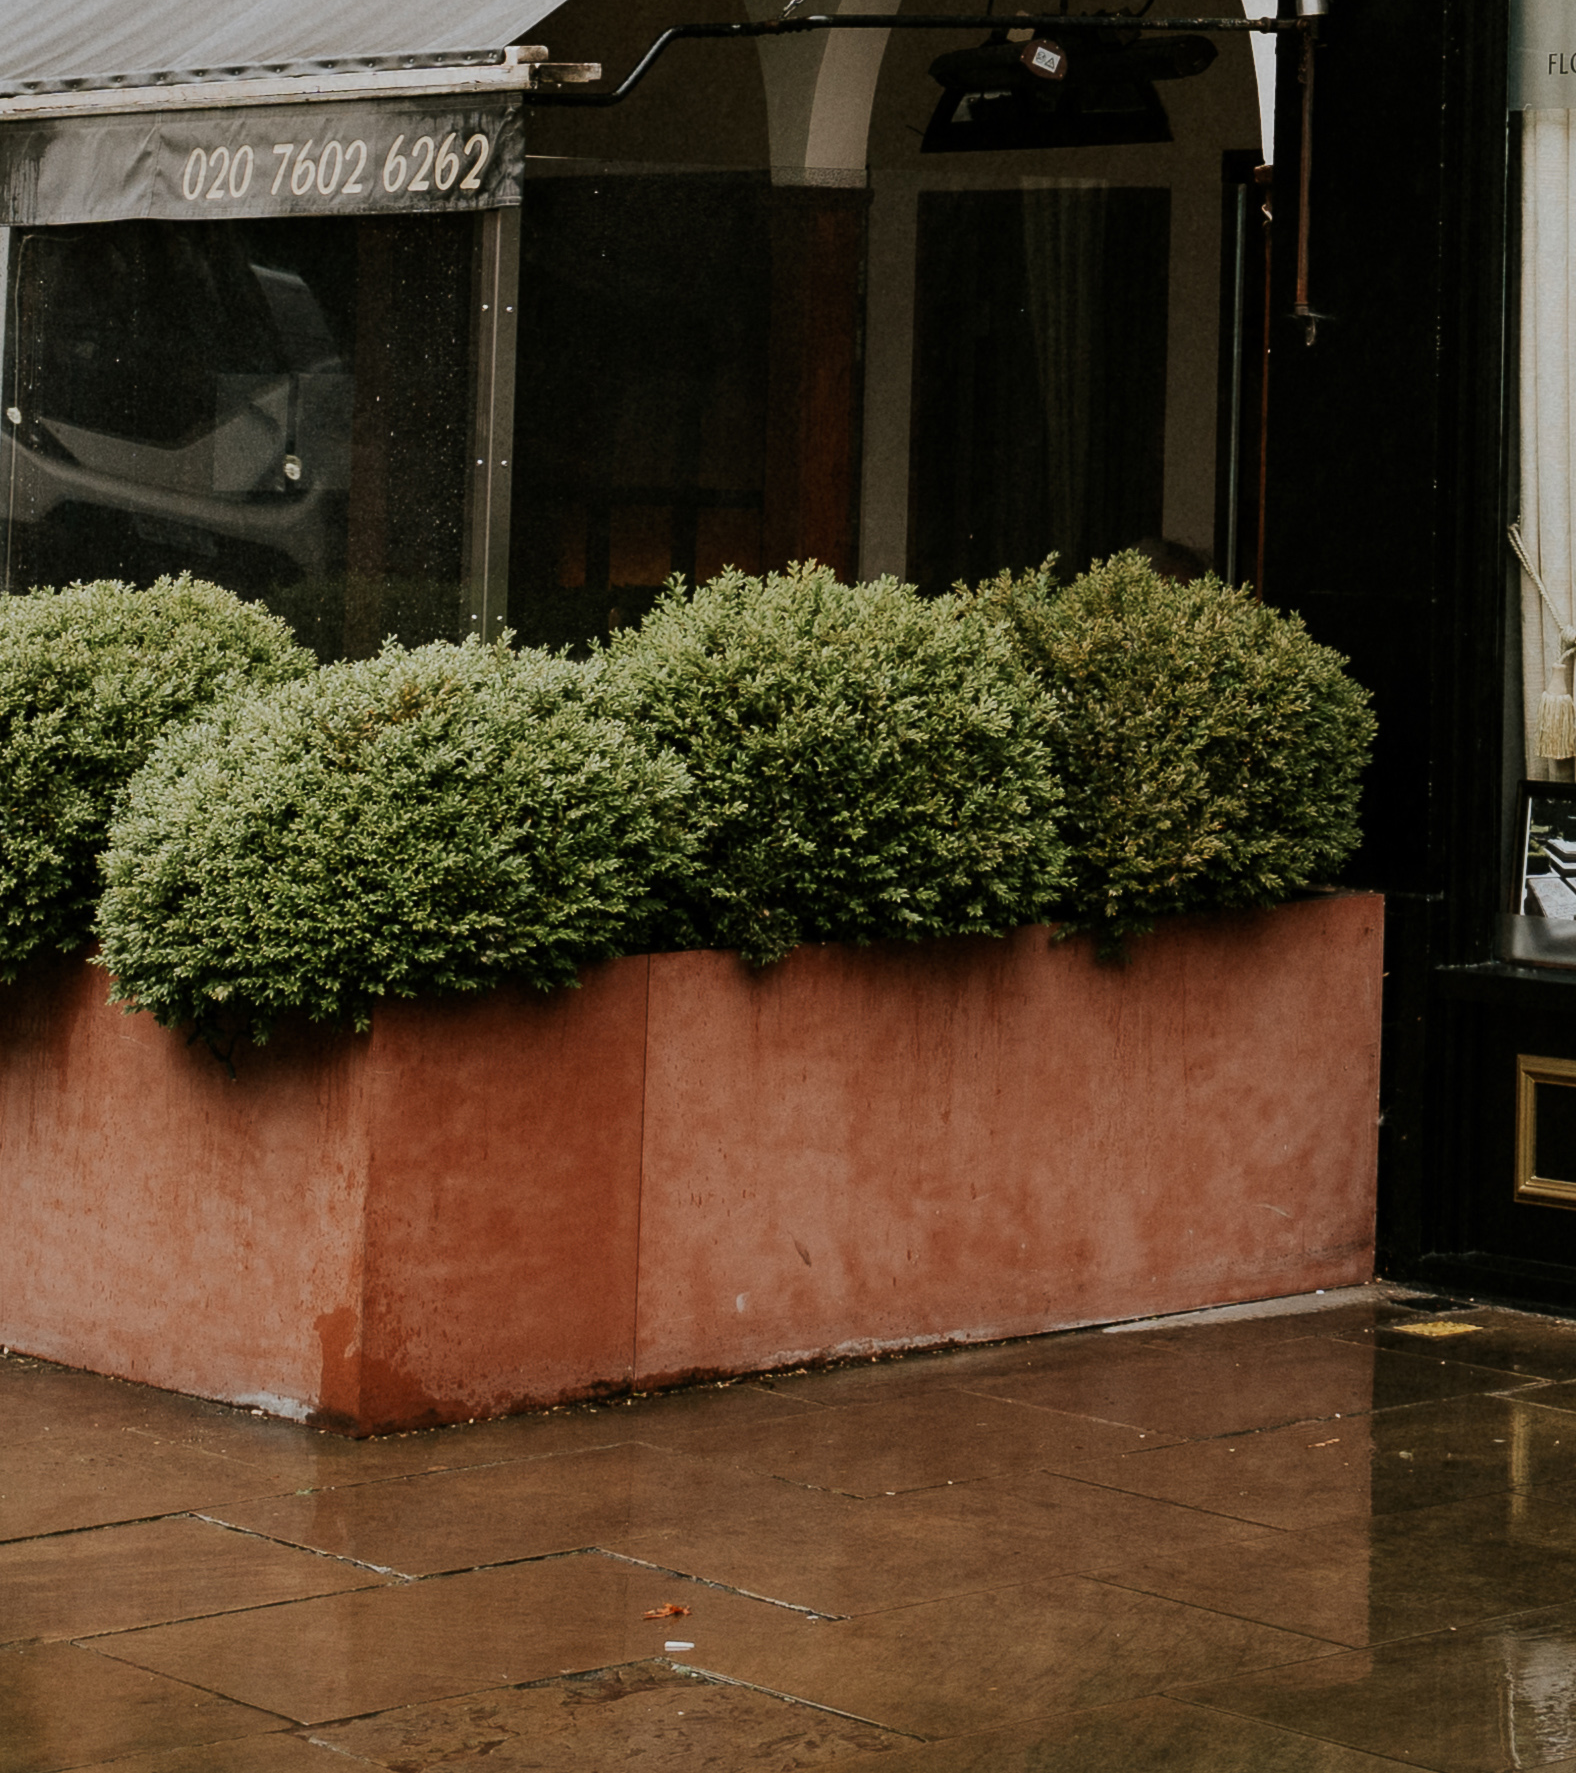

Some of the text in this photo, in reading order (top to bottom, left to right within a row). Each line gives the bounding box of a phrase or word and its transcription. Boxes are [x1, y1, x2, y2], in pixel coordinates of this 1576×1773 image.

[182, 132, 489, 201] 020 7602 6262
